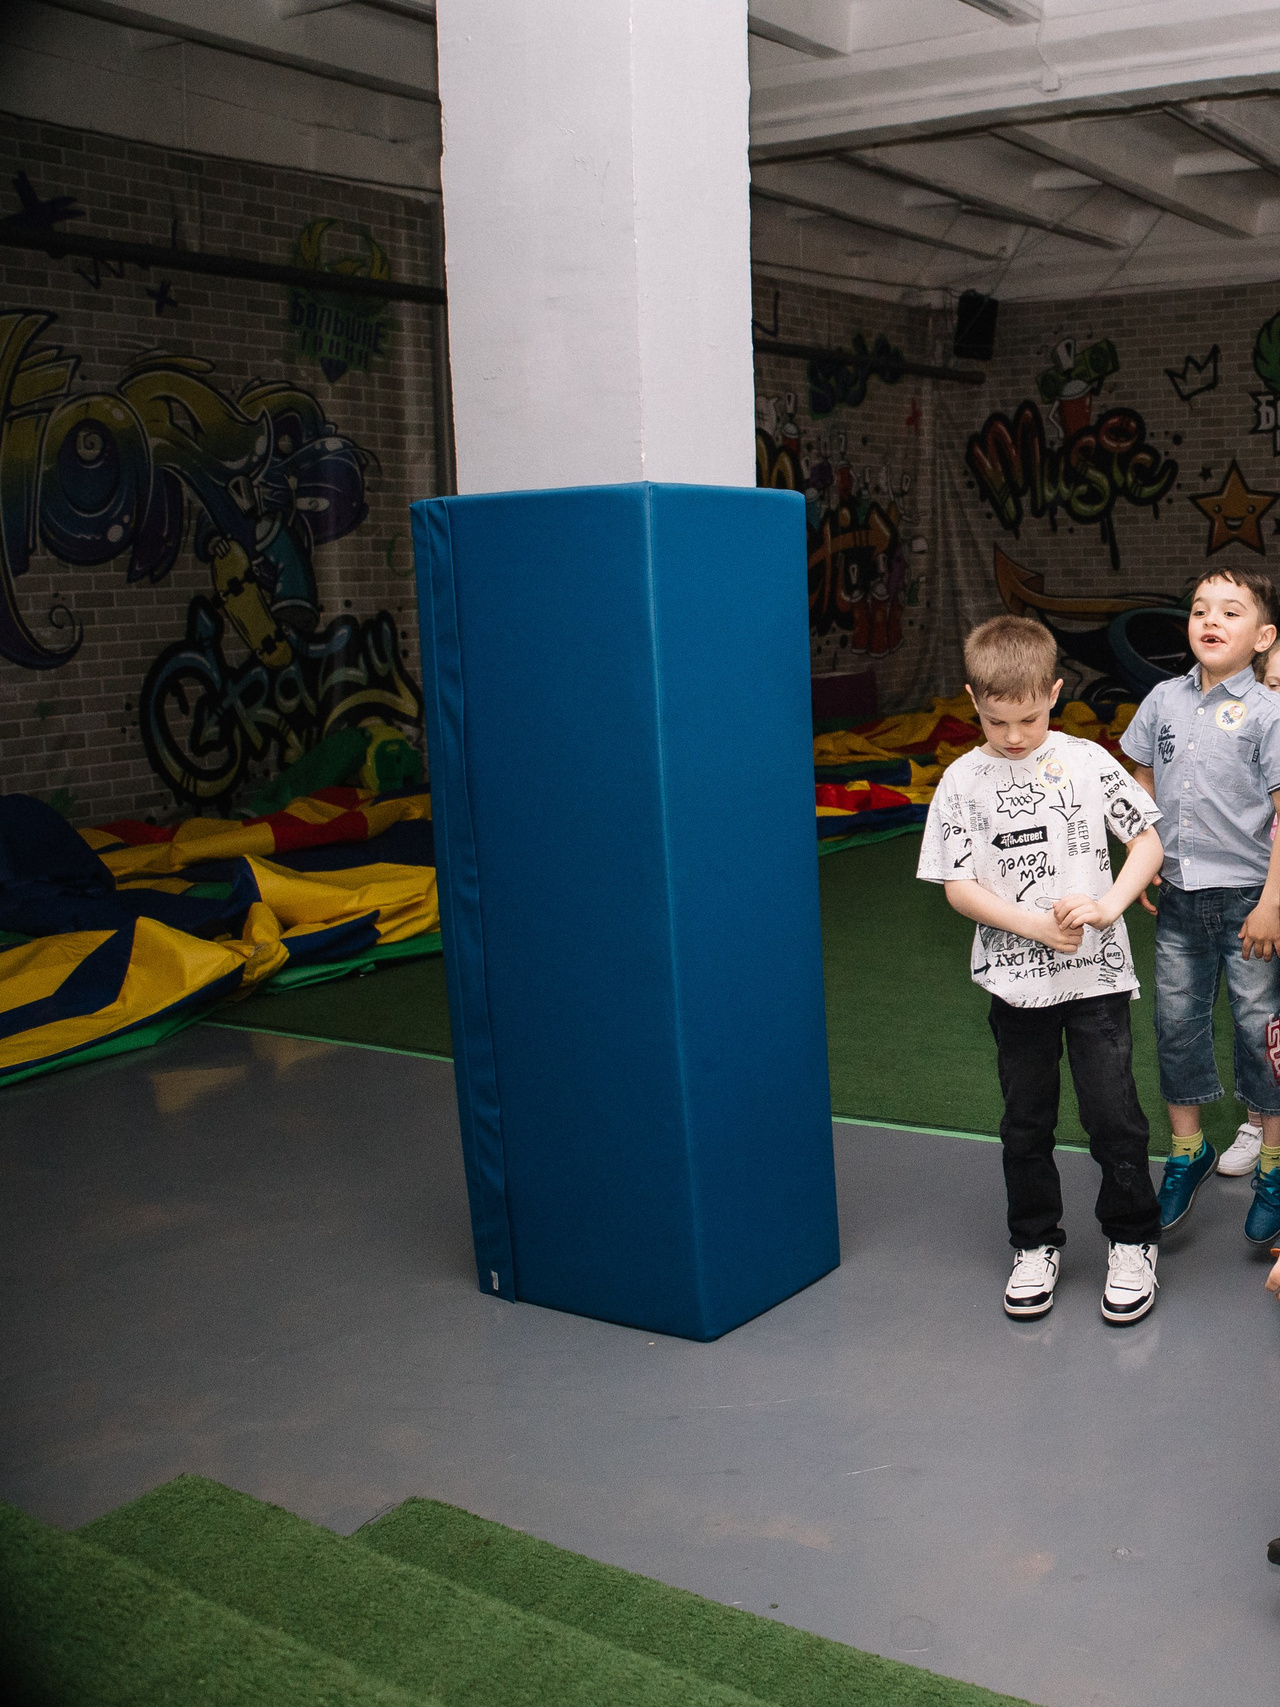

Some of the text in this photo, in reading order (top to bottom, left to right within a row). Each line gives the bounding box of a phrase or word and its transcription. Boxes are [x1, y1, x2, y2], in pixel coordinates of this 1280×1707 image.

[1104, 779, 1127, 799] best
[1067, 822, 1078, 857] ROLLING
[1077, 819, 1090, 854] KEEP ON
[997, 851, 1048, 878] level
[1020, 864, 1056, 882] new
[995, 951, 1025, 967] DAY
